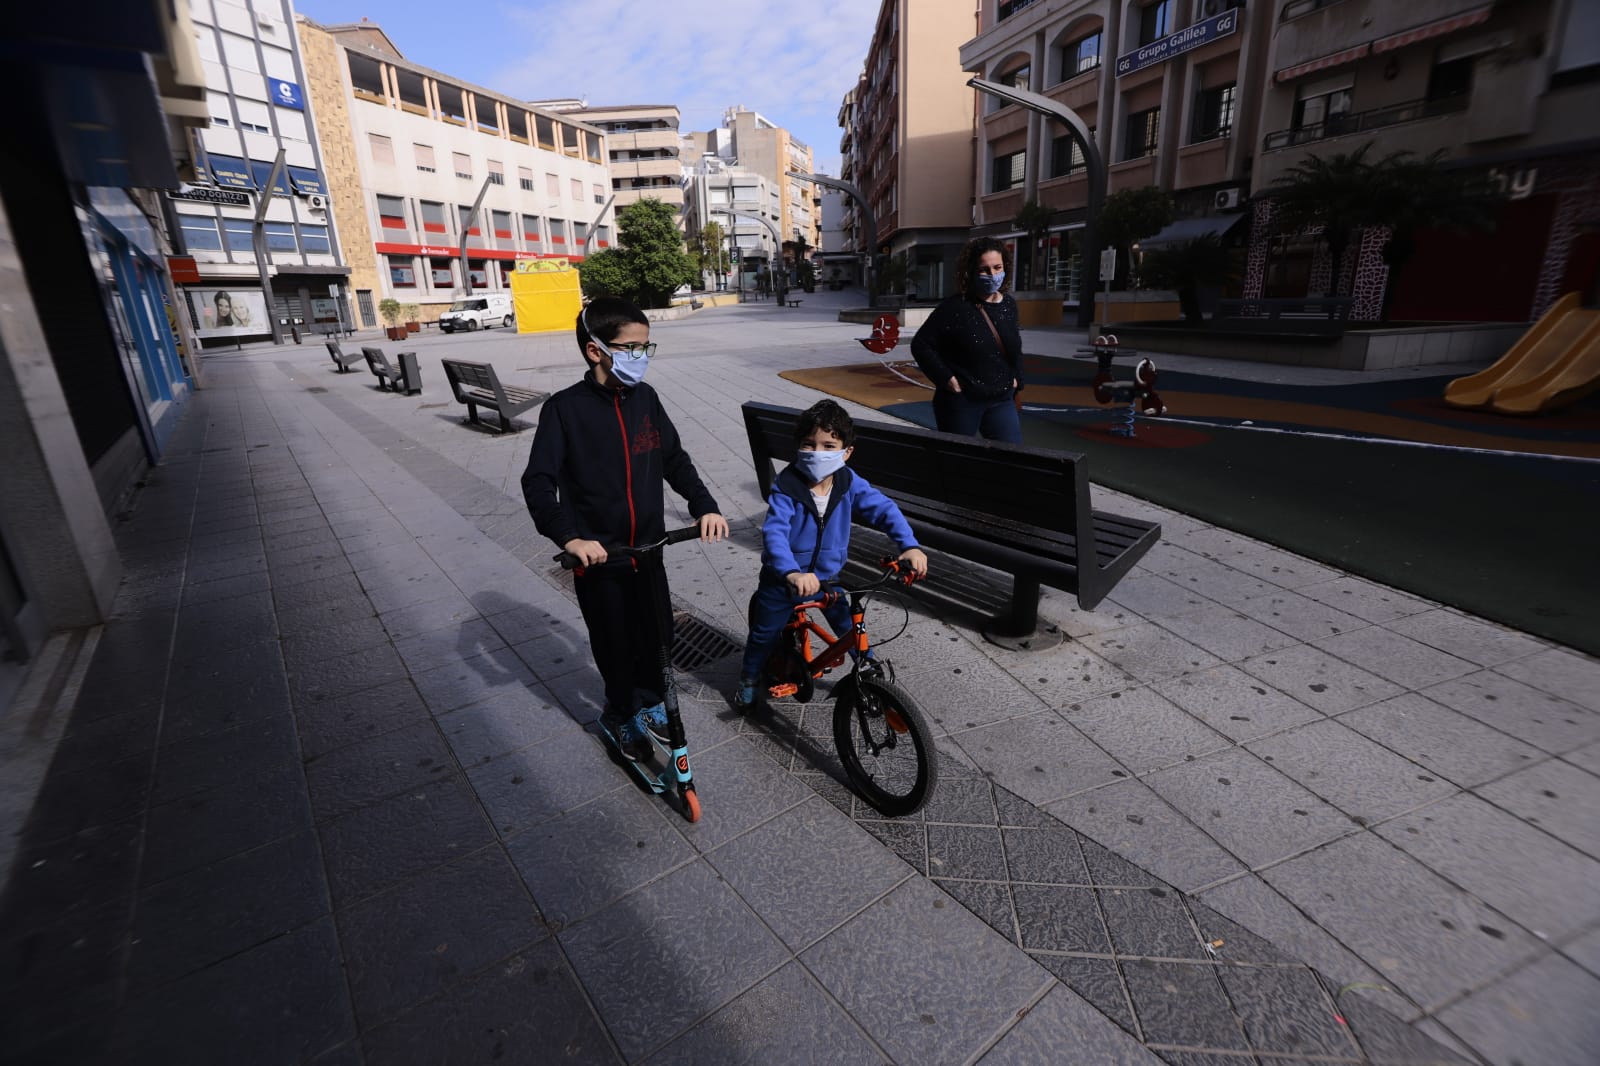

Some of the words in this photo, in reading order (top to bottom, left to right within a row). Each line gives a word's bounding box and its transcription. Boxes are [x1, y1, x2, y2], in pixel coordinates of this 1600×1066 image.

[1119, 59, 1130, 71] GG
[1138, 42, 1167, 60] Grupo
[1169, 25, 1206, 47] Galilea
[1216, 16, 1231, 32] GG
